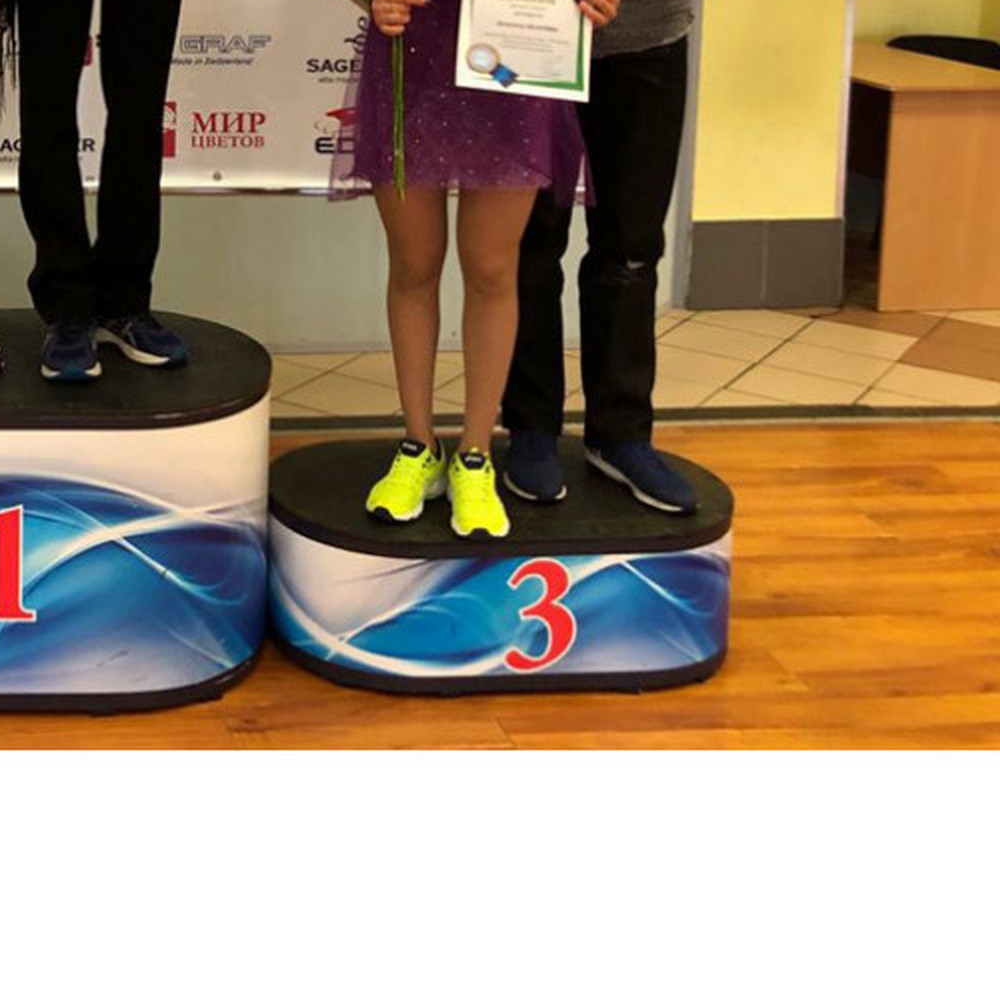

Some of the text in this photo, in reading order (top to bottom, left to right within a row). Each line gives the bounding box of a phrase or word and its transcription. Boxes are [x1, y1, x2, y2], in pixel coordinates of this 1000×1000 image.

[181, 35, 272, 54] GRAF
[192, 112, 267, 133] МИР
[191, 135, 265, 149] ЦВЕТОВ
[505, 557, 577, 675] 3
